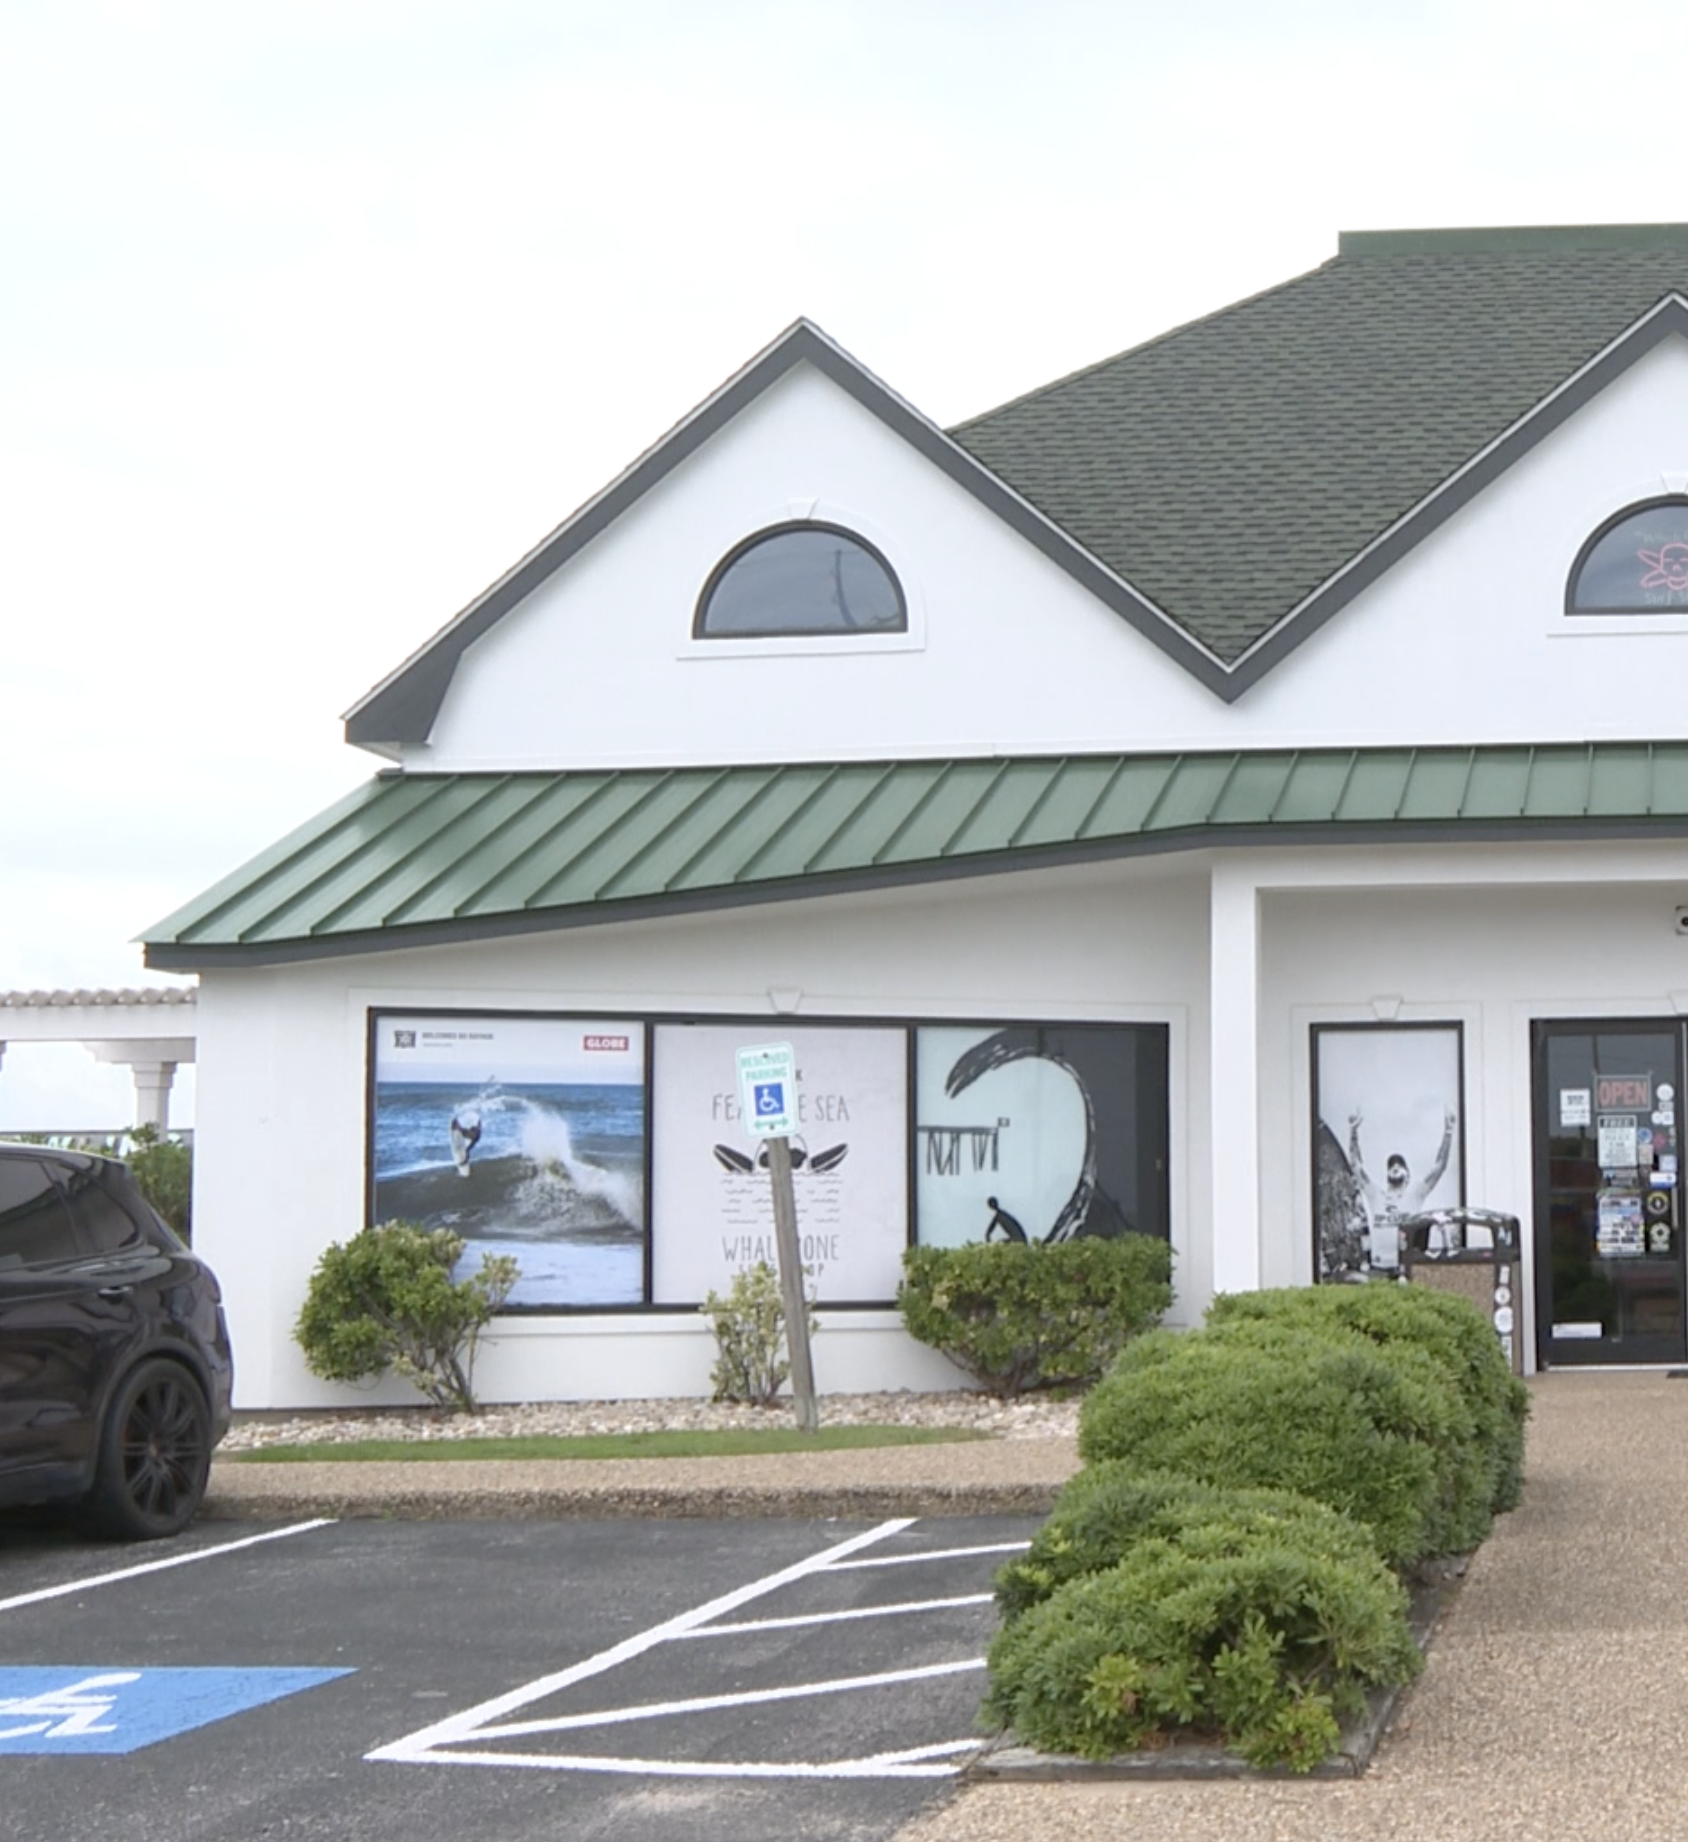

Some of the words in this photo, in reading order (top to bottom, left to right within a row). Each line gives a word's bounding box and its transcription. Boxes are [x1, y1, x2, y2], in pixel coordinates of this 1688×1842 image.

[586, 1037, 626, 1049] GLOBE
[745, 1066, 787, 1081] PARKING
[1599, 1080, 1648, 1106] OPEN
[814, 1094, 850, 1122] SEA
[722, 1234, 840, 1262] WHALONE
